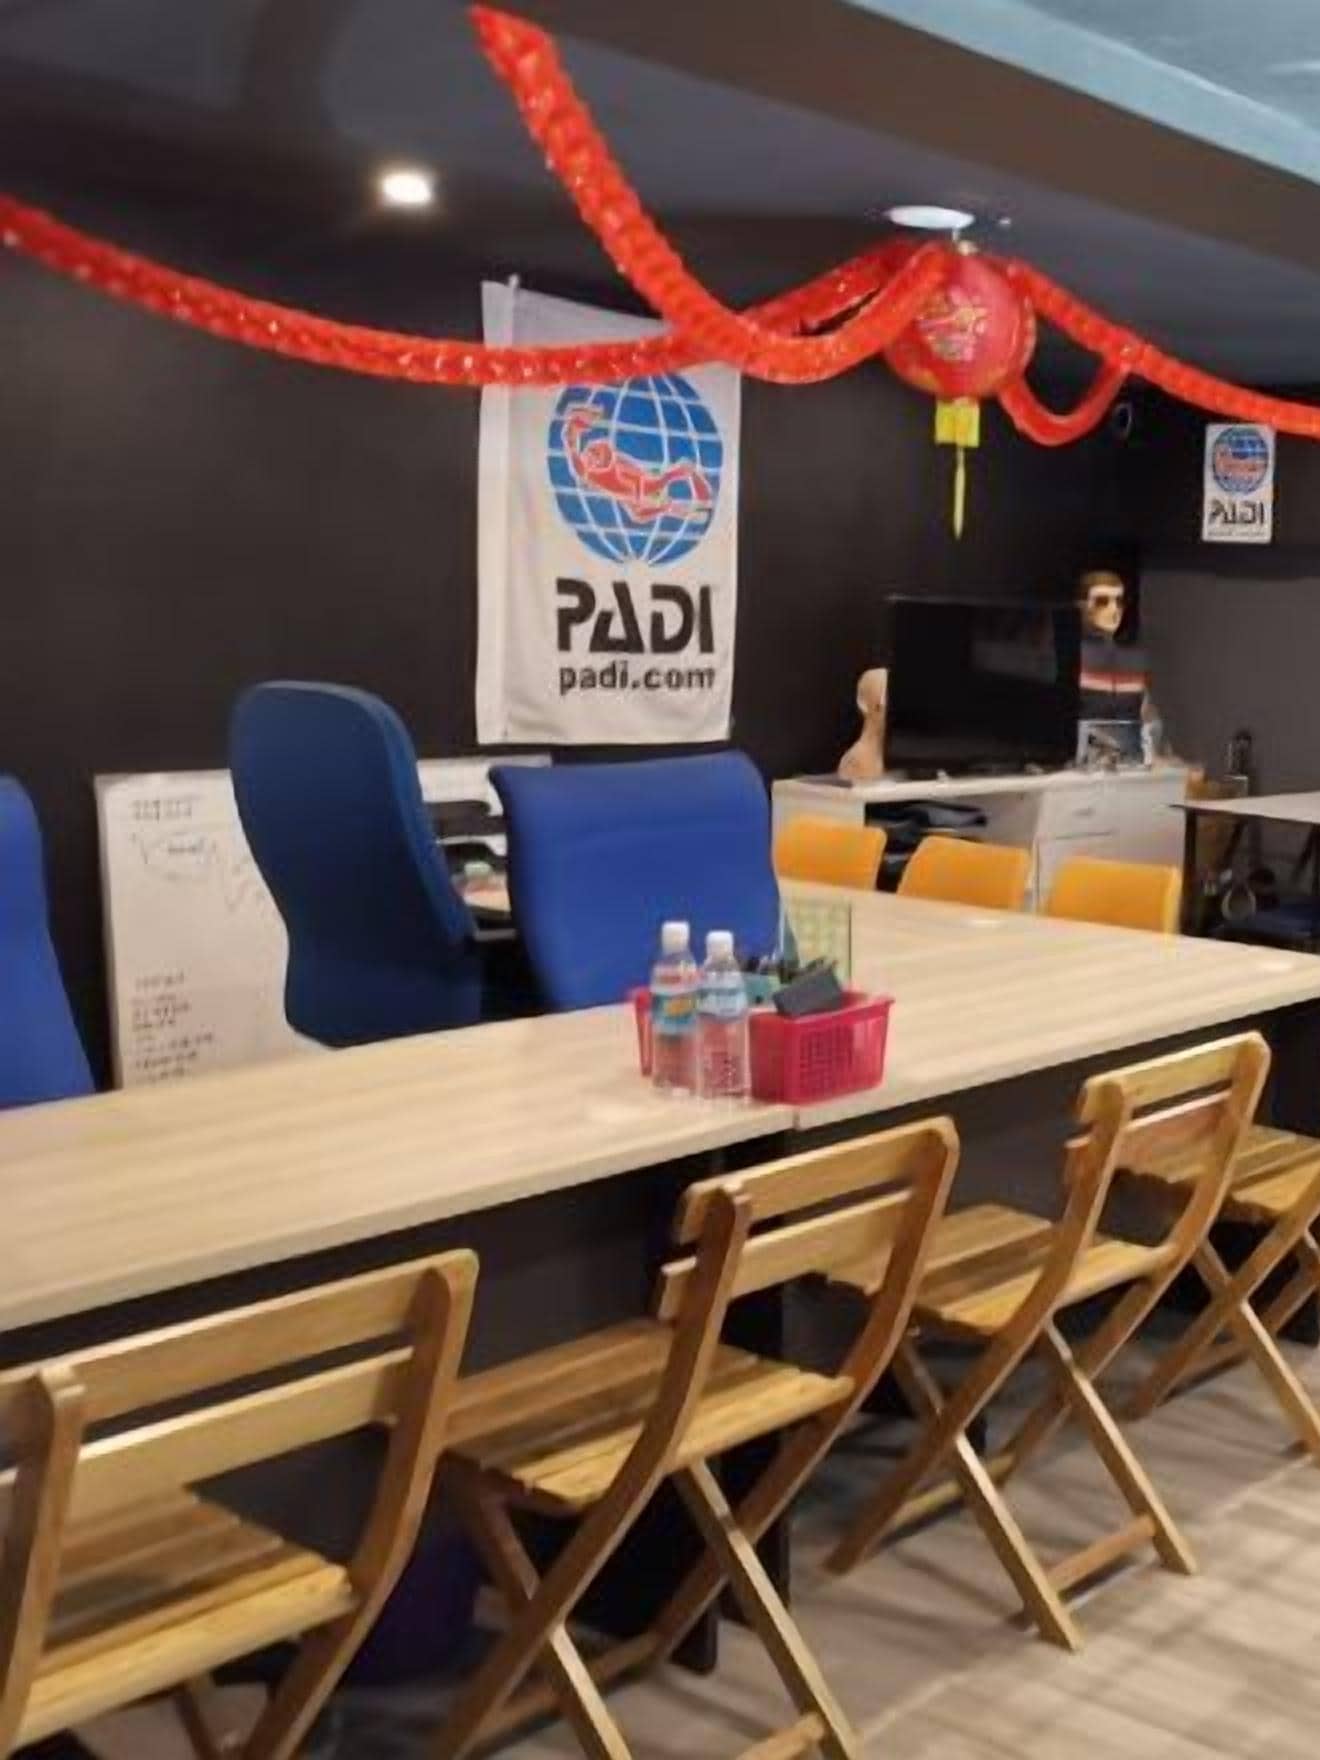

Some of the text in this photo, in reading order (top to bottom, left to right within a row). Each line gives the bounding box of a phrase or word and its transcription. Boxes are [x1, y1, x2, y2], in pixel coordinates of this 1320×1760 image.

[1208, 500, 1265, 525] PADI
[556, 577, 715, 654] PADI
[559, 660, 716, 696] padi.com
